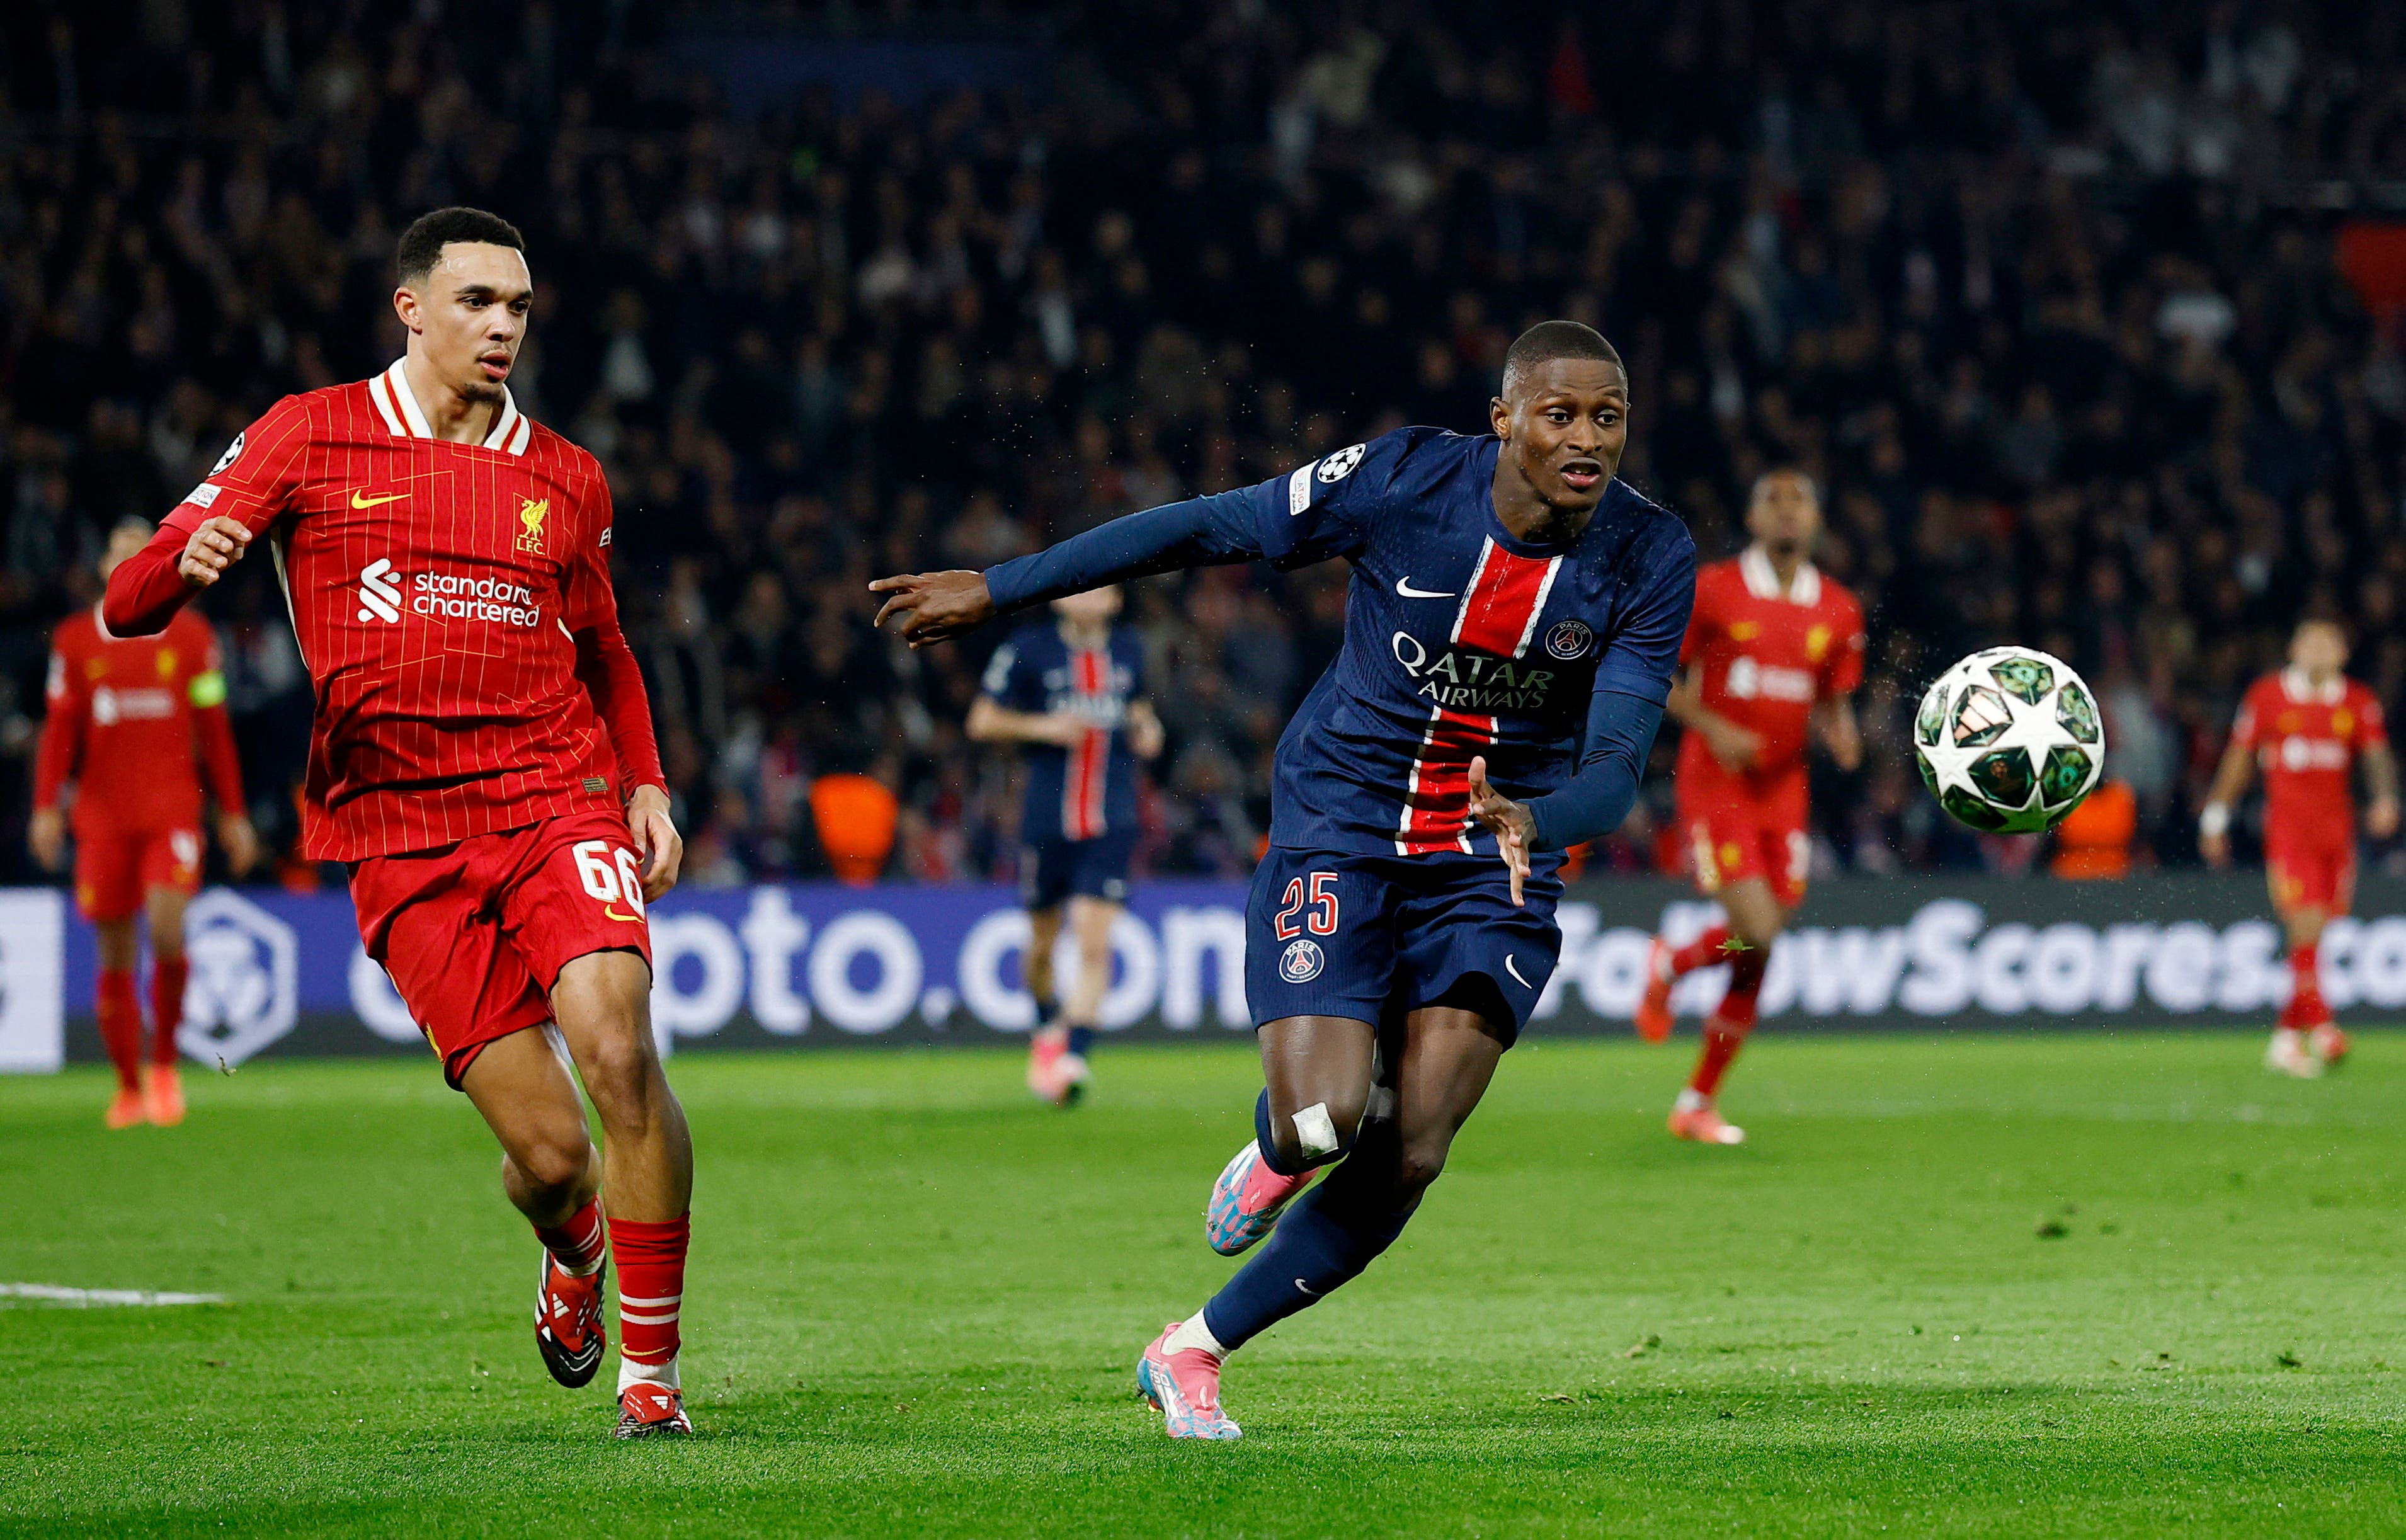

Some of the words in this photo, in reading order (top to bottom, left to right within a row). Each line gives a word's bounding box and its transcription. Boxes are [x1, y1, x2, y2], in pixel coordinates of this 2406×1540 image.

[414, 570, 532, 605] standard
[413, 593, 540, 627] chartered
[1559, 623, 1588, 635] PARIS
[1392, 630, 1554, 690] QATAR
[1418, 680, 1547, 709] AIRWAYS
[572, 840, 646, 921] 66
[1275, 872, 1339, 942] 25
[1286, 942, 1315, 956] PARIS
[348, 883, 1248, 1061] cpto.com
